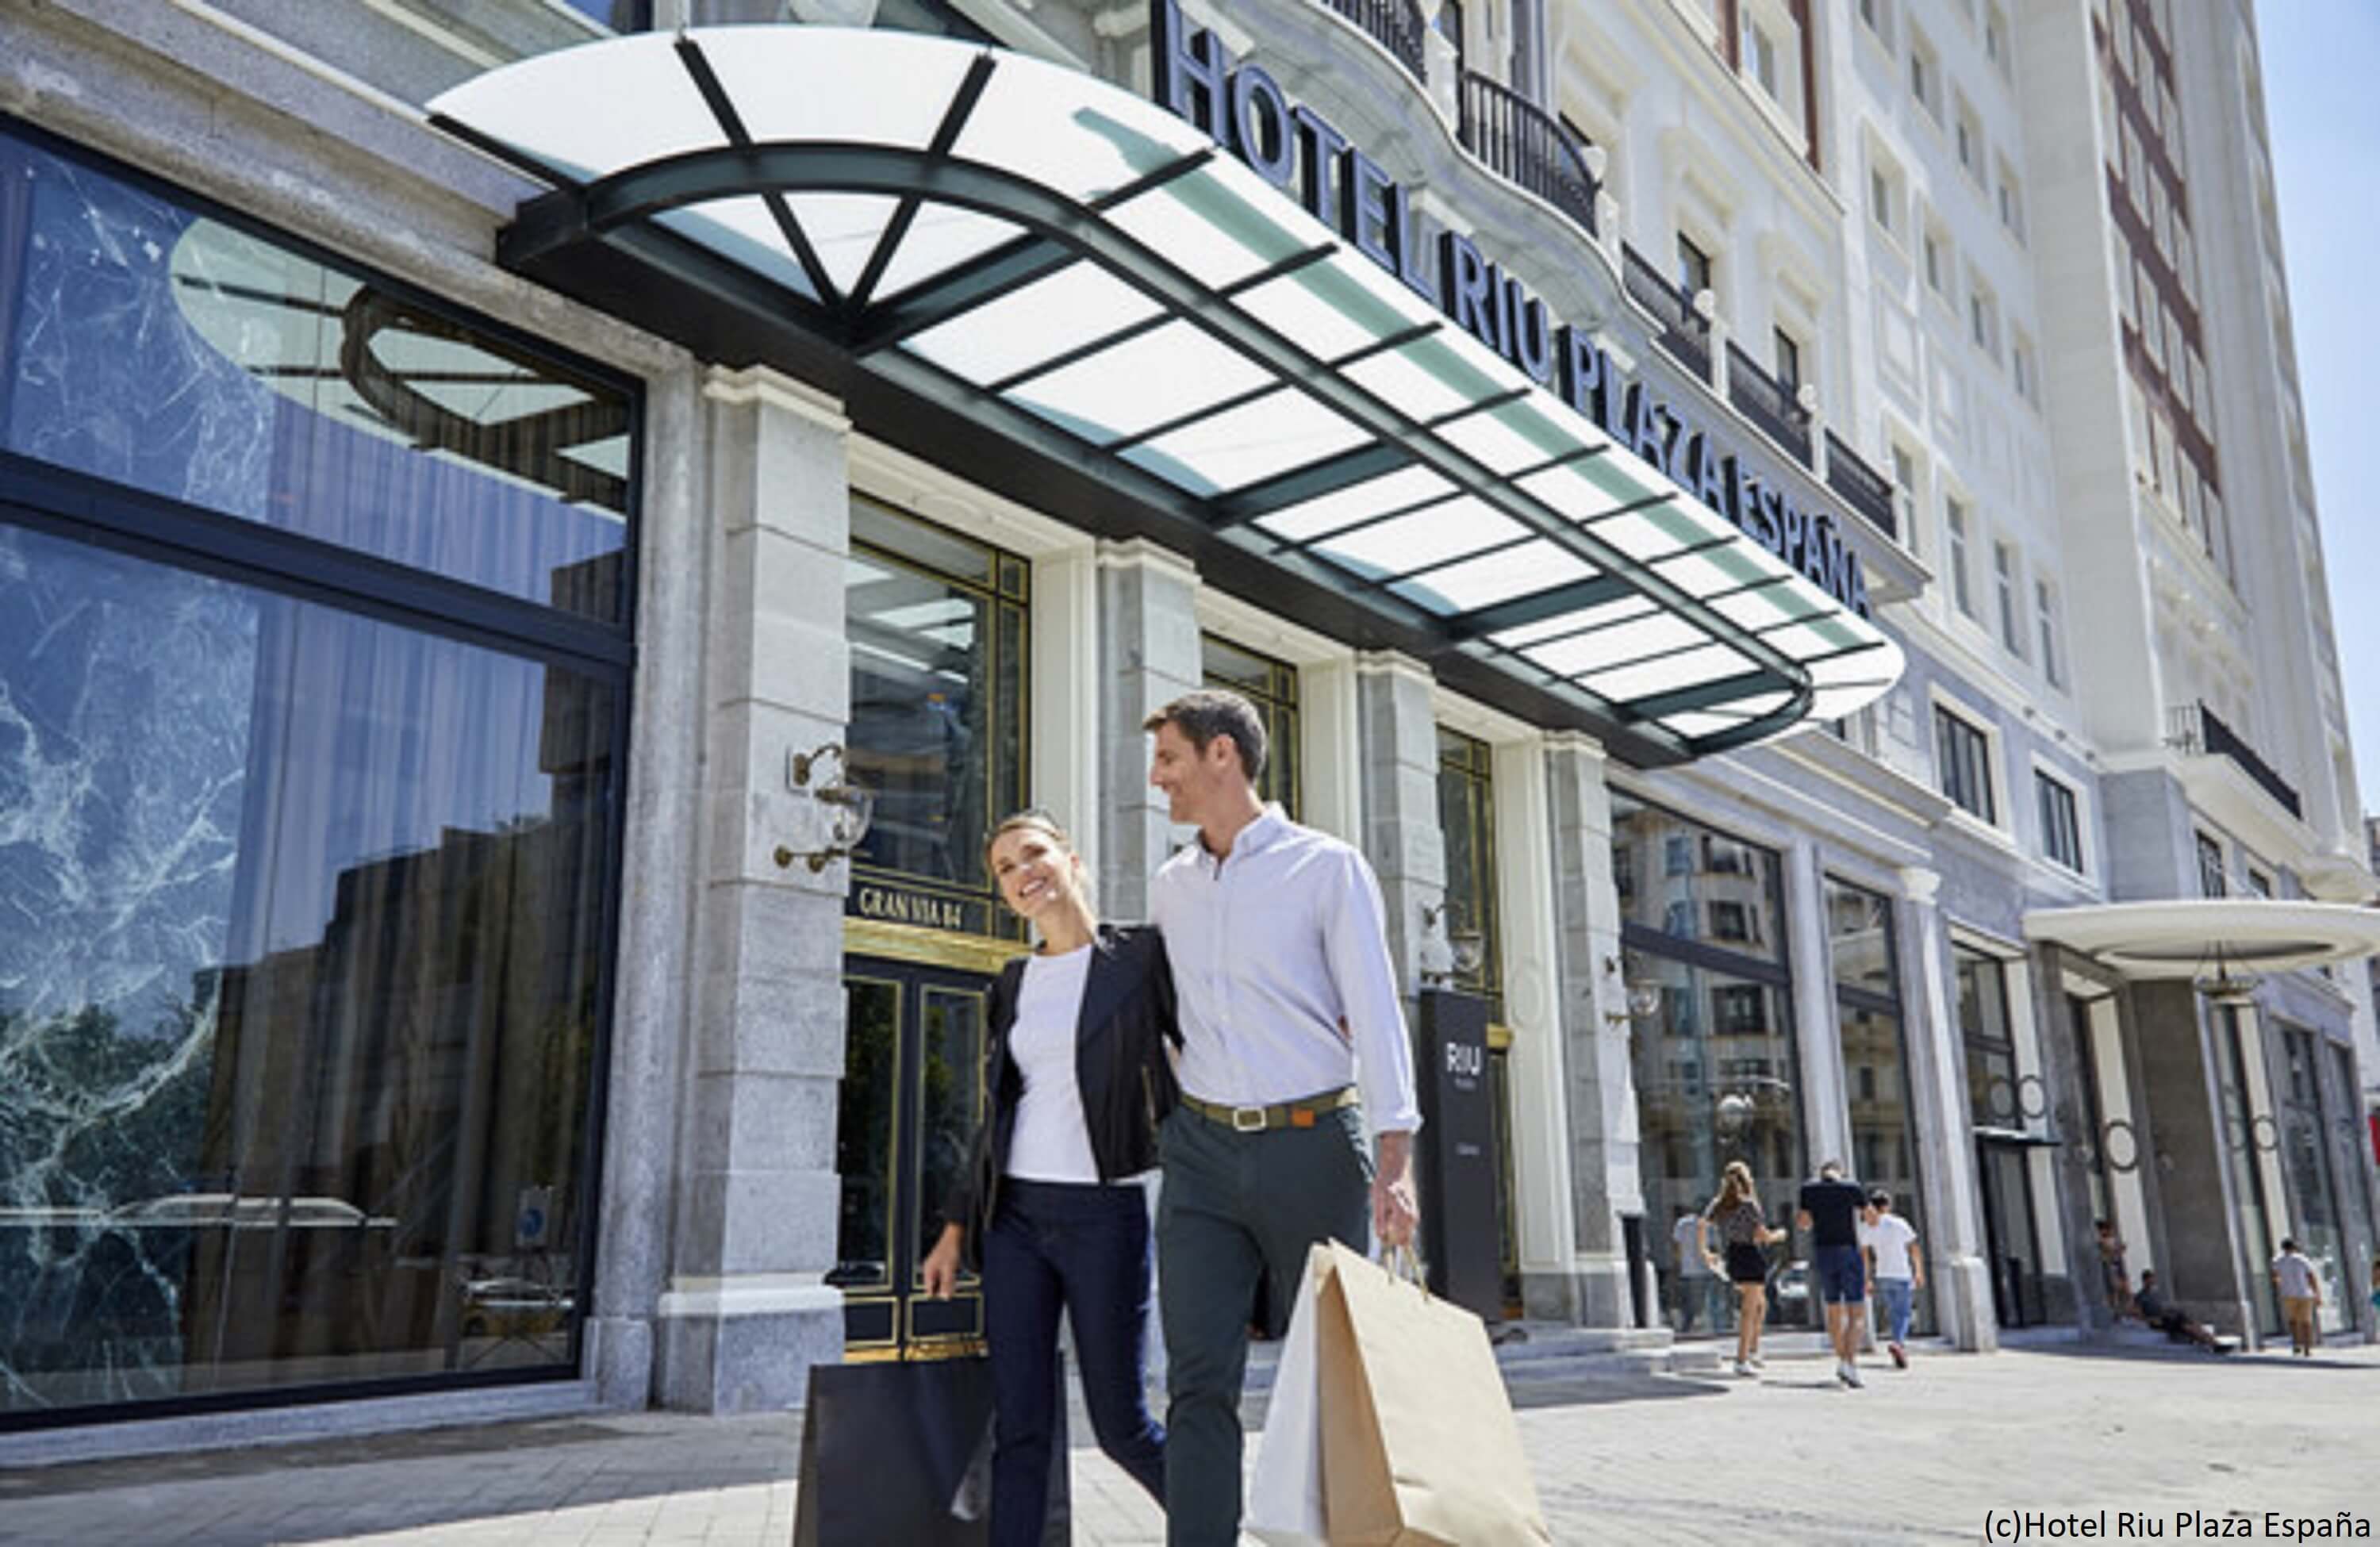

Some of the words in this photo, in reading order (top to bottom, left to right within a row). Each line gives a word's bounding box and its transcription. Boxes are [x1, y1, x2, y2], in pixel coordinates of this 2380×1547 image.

[1152, 0, 1434, 306] HOTEL
[1440, 230, 1553, 384] RIU
[1558, 324, 1727, 520] PLAZA
[1724, 455, 1869, 620] ESPAÑA
[859, 887, 909, 921] GRAN
[1446, 1042, 1481, 1076] RIU
